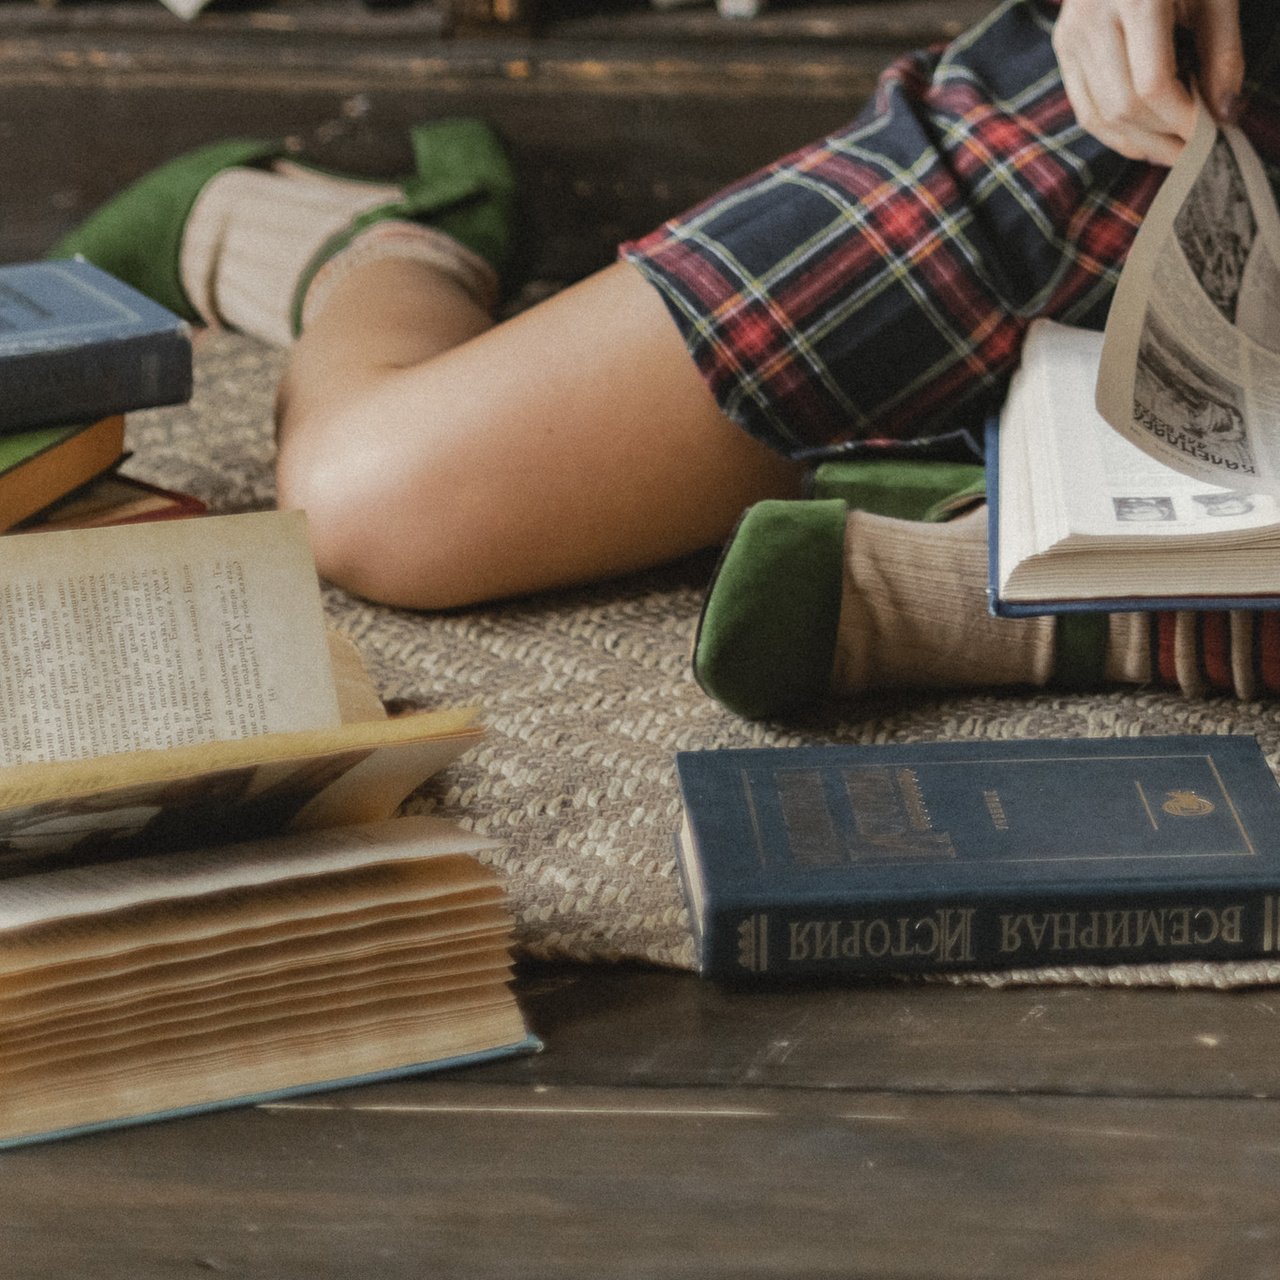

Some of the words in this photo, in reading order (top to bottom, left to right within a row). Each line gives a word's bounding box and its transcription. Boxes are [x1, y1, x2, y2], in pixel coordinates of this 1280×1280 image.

[39, 617, 53, 650] Жуков
[125, 623, 138, 653] целый
[139, 631, 150, 663] достал
[20, 645, 34, 679] Жуков
[18, 713, 33, 751] Жукова
[118, 704, 130, 740] руками
[225, 709, 235, 726] ней
[34, 727, 42, 749] него
[55, 716, 67, 756] родился
[787, 908, 977, 963] ИСТОРИЯ
[1001, 905, 1245, 953] ВСЕМИРНАЯ
